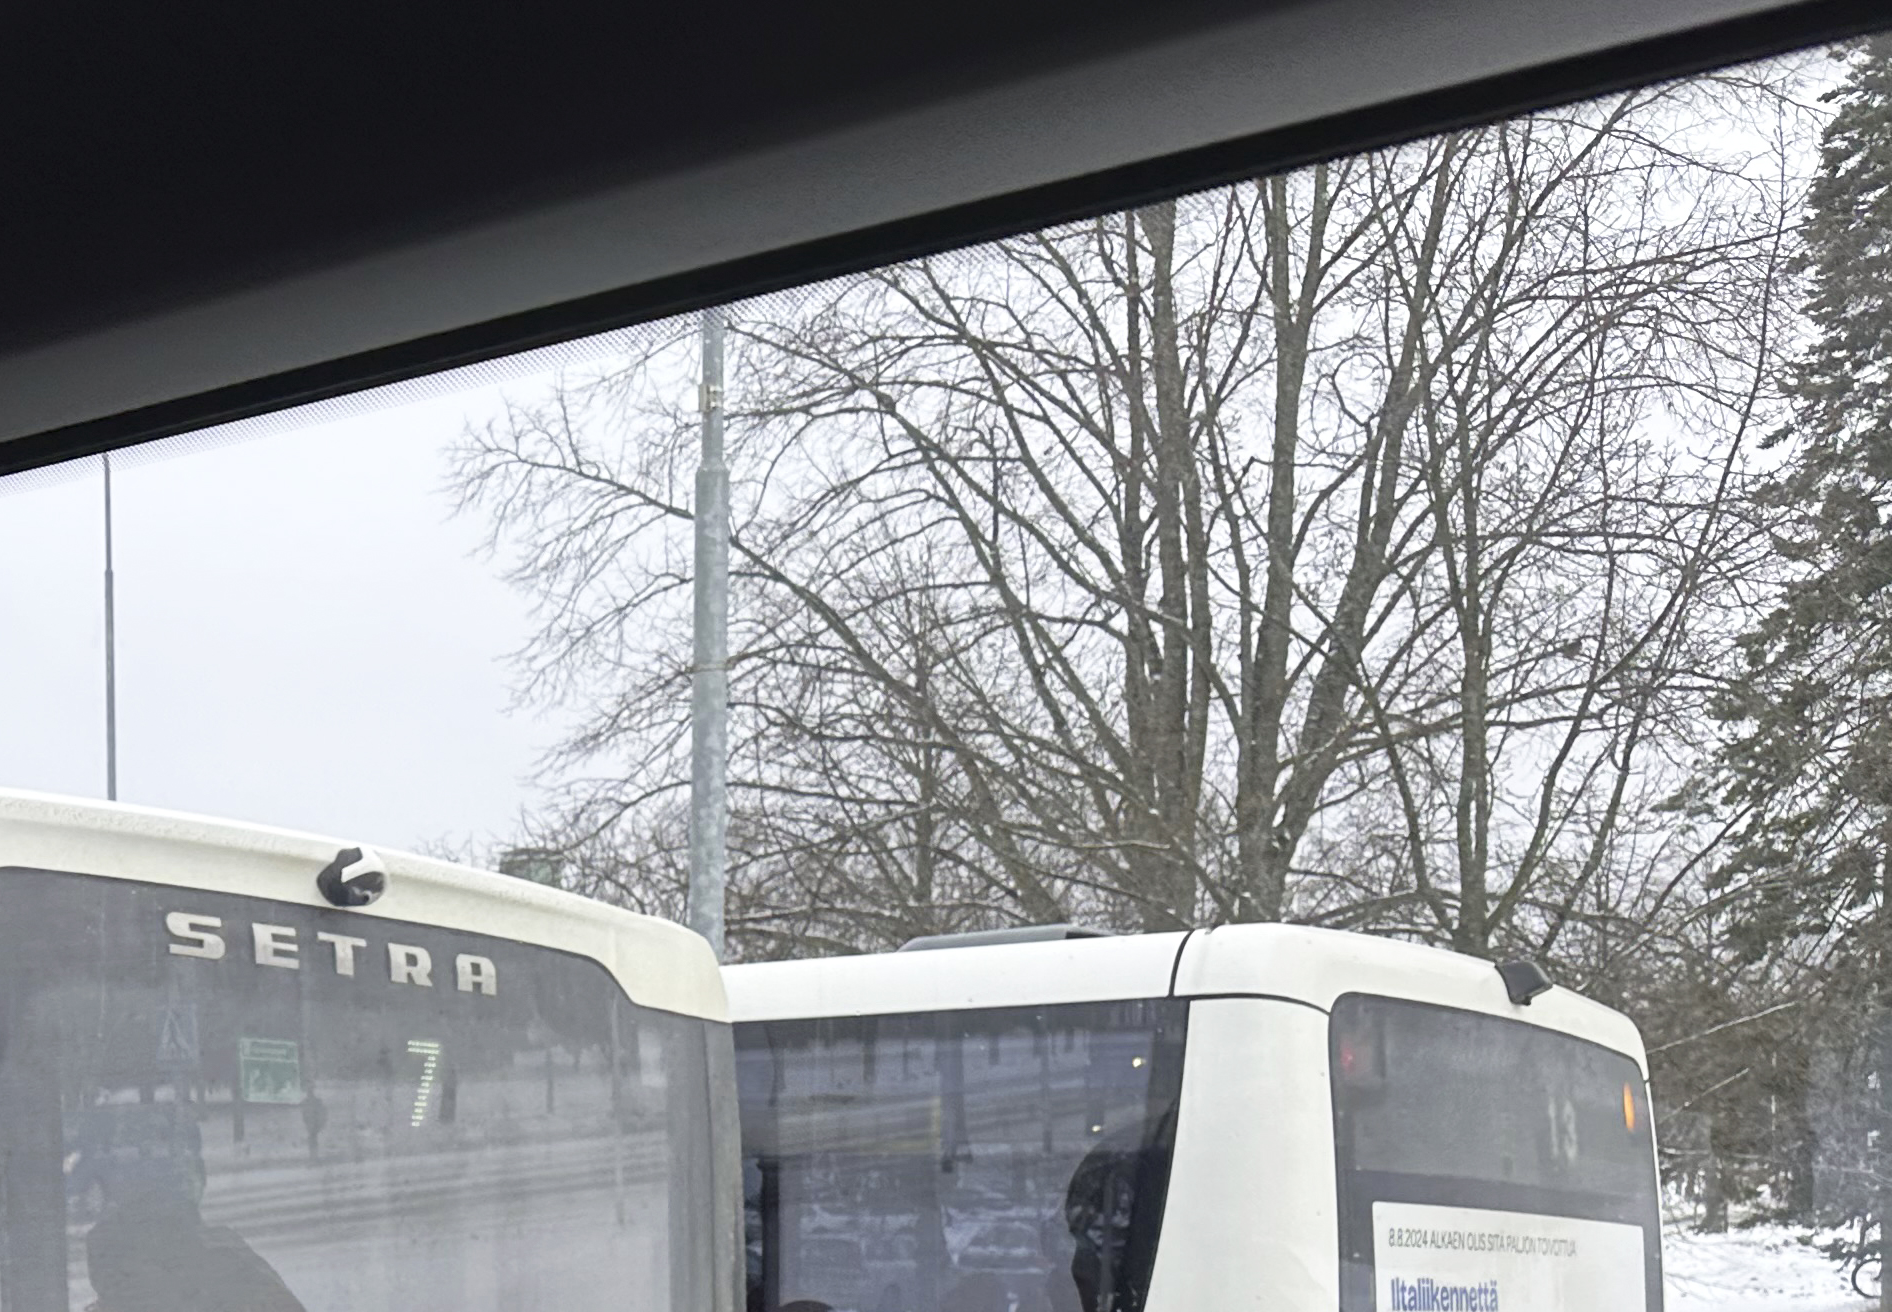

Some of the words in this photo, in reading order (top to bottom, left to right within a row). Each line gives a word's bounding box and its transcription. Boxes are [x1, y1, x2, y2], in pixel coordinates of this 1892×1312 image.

[166, 911, 497, 996] SETRA
[407, 1040, 441, 1127] 7
[1388, 1228, 1427, 1248] 8.8.2024
[1429, 1230, 1465, 1250] ALKAEN
[1391, 1277, 1499, 1312] Iltaliikennettä
